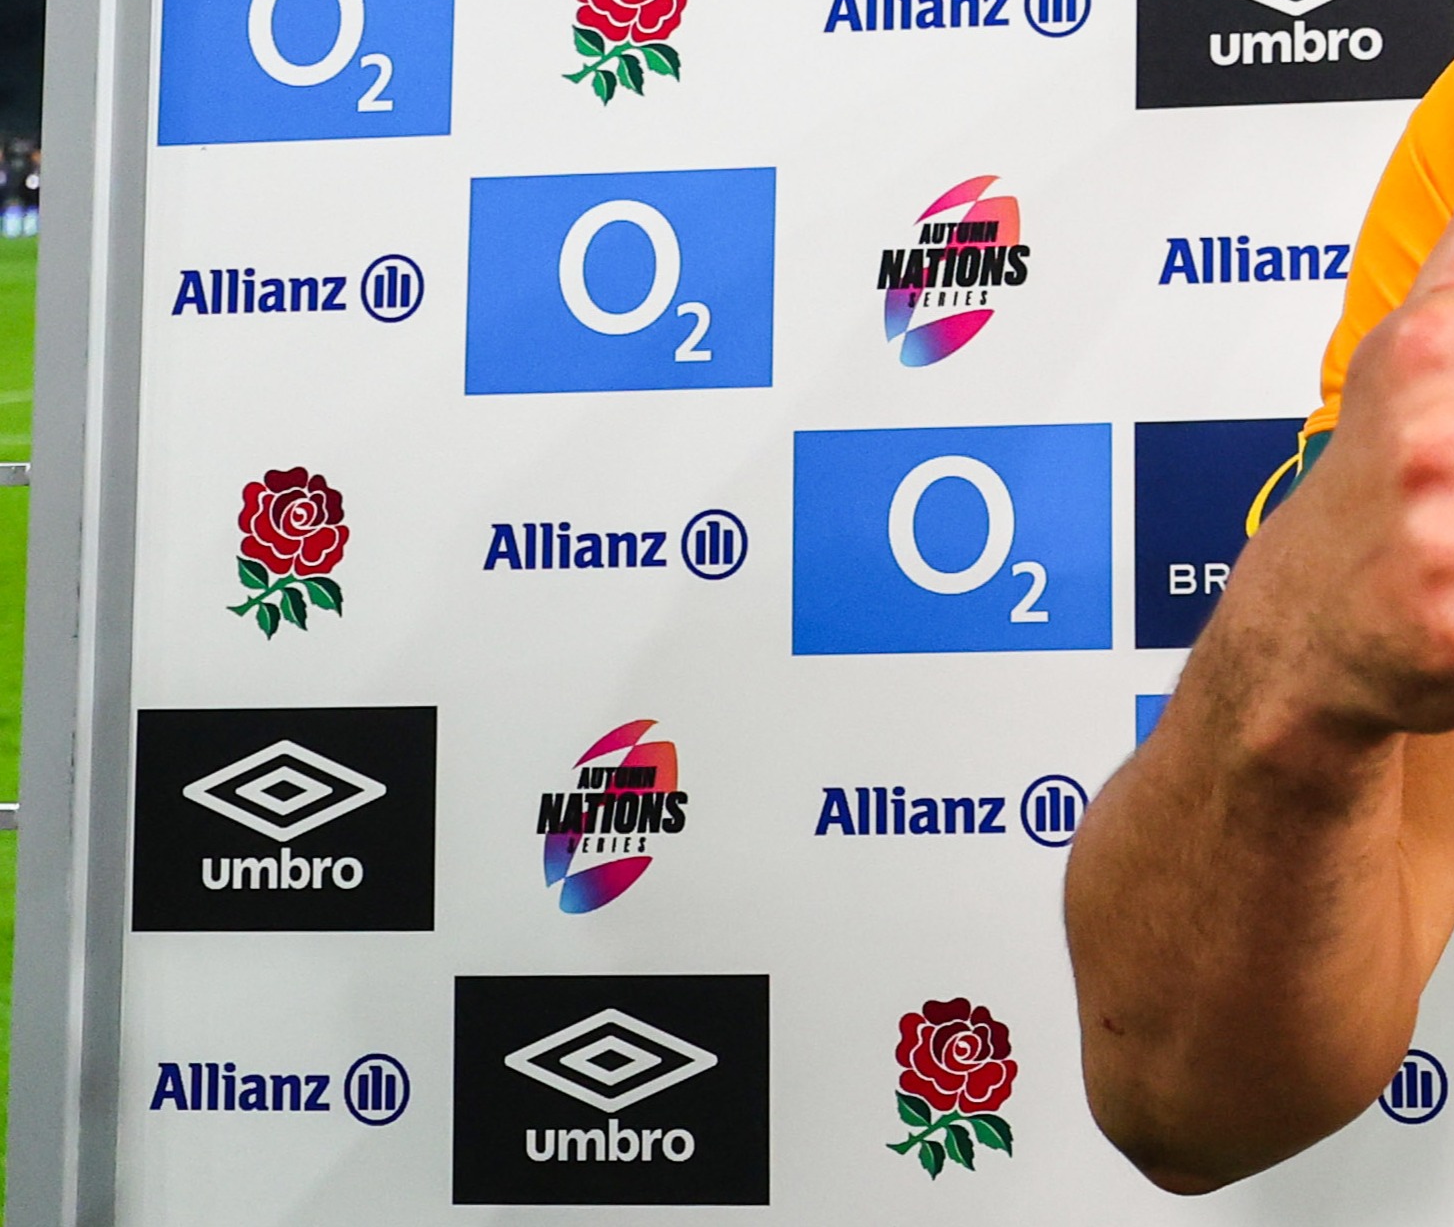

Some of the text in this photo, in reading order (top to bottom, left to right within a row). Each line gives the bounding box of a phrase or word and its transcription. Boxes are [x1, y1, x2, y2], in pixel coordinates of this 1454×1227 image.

[1209, 20, 1383, 66] umbro
[917, 220, 1000, 245] AUTUMN
[875, 244, 1031, 291] NATIONS
[1158, 234, 1351, 285] Allianz
[172, 268, 347, 316] Allianz
[907, 289, 989, 309] SERIES
[484, 522, 666, 570] Allianz
[576, 765, 658, 790] AUTUMN
[535, 790, 689, 835] NATIONS
[816, 786, 1005, 836] Allianz
[566, 835, 647, 854] SERIES
[202, 847, 363, 890] umbro
[151, 1062, 329, 1111] Allianz
[526, 1118, 695, 1162] umbro
